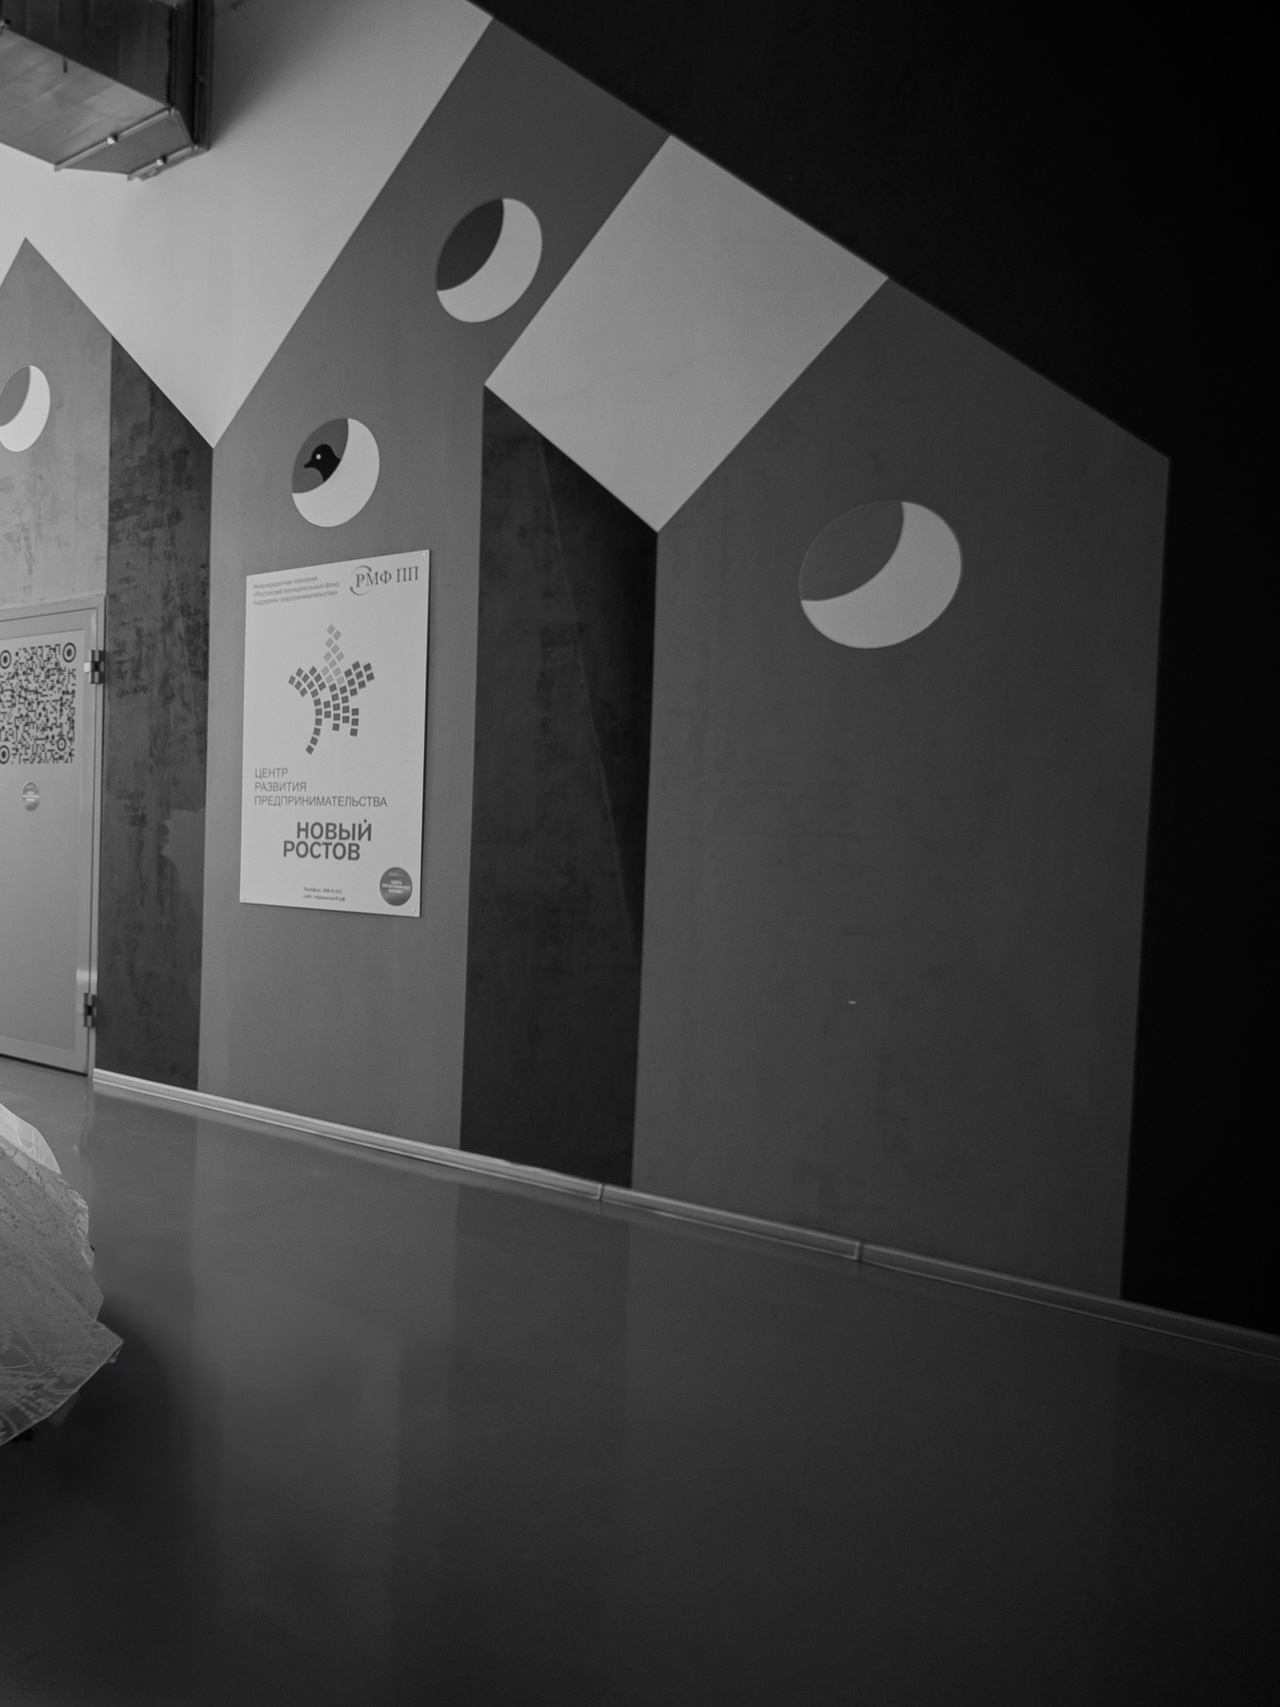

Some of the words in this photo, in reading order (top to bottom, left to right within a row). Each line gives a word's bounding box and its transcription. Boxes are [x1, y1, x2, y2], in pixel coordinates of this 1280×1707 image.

[355, 569, 392, 588] РМФ
[396, 566, 419, 583] ПП
[254, 767, 288, 779] ЦЕНТР
[254, 781, 307, 792] РАЗВИТИЯ
[254, 795, 388, 808] ПРЕДПРИНИМАТЕЛЬСТВА
[296, 818, 372, 842] НОВЫЙ
[283, 840, 361, 861] РОСТОВ
